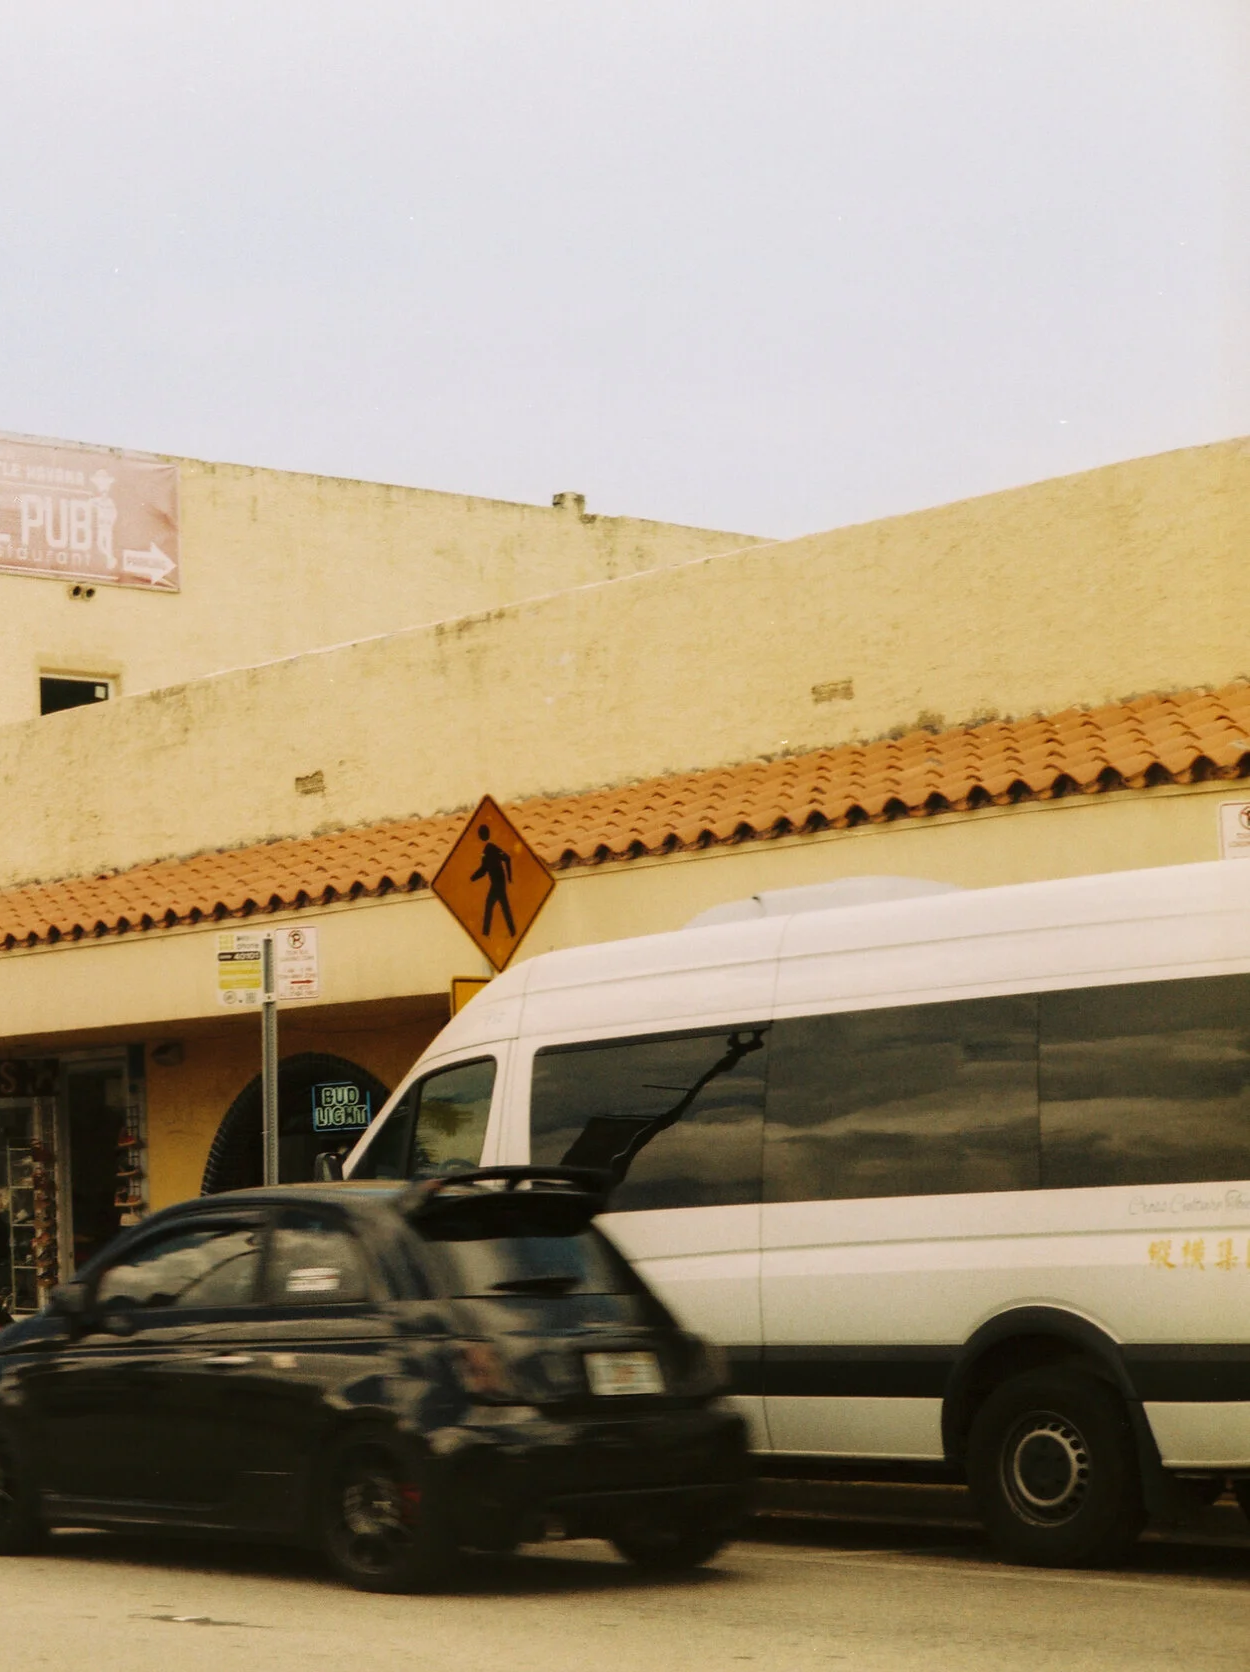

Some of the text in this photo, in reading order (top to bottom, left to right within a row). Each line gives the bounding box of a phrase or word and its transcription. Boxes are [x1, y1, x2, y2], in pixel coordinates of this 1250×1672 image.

[20, 493, 92, 551] PUB
[321, 1086, 360, 1106] BUD
[315, 1105, 368, 1127] LIGHT
